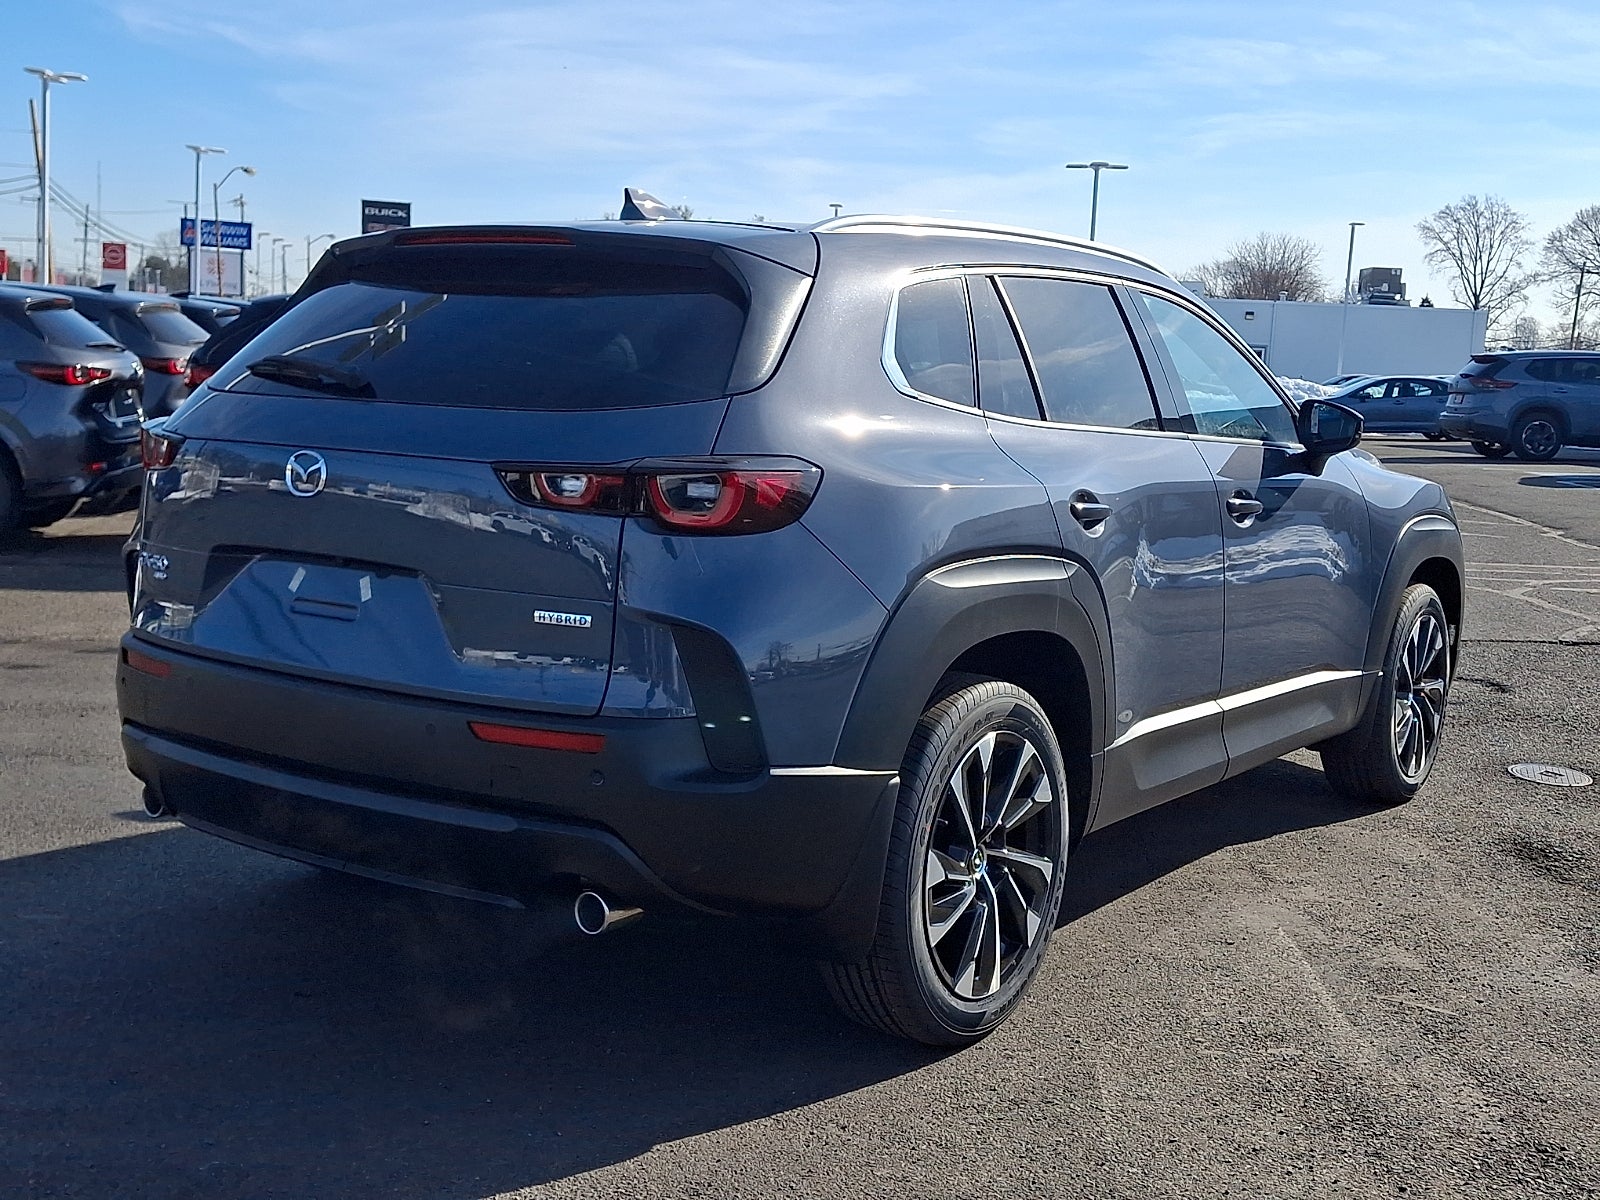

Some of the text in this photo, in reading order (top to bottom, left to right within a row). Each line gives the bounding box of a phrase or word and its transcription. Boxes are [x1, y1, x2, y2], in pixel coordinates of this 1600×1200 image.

[364, 206, 408, 218] BUICK
[201, 221, 248, 236] SHRWIN
[538, 612, 588, 626] HYBRID
